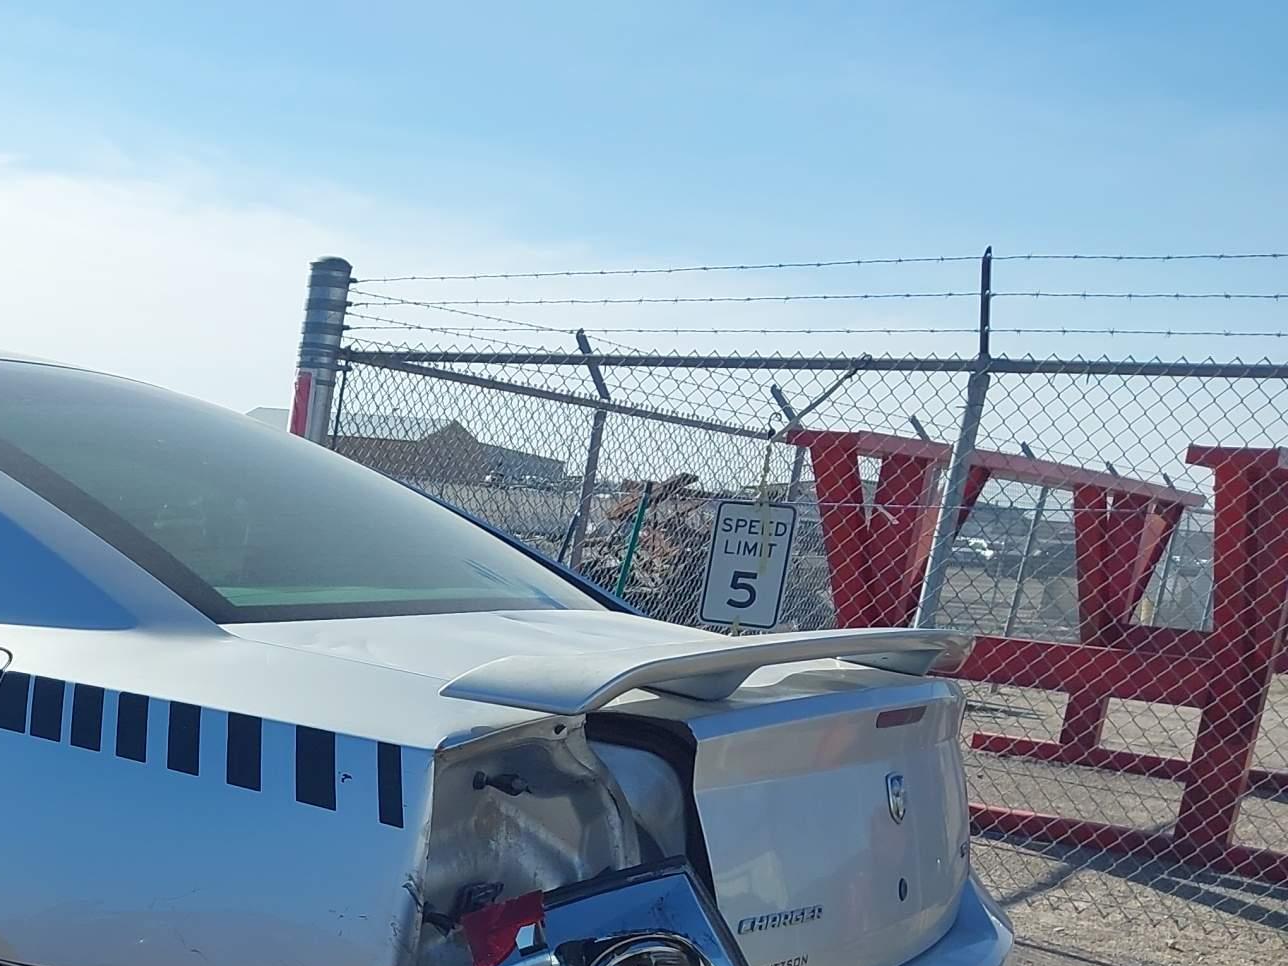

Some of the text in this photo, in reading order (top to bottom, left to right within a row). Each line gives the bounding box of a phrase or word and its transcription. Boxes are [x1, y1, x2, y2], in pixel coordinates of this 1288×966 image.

[723, 539, 777, 558] LIMIT
[726, 570, 758, 609] 5
[737, 905, 824, 935] CHARGER
